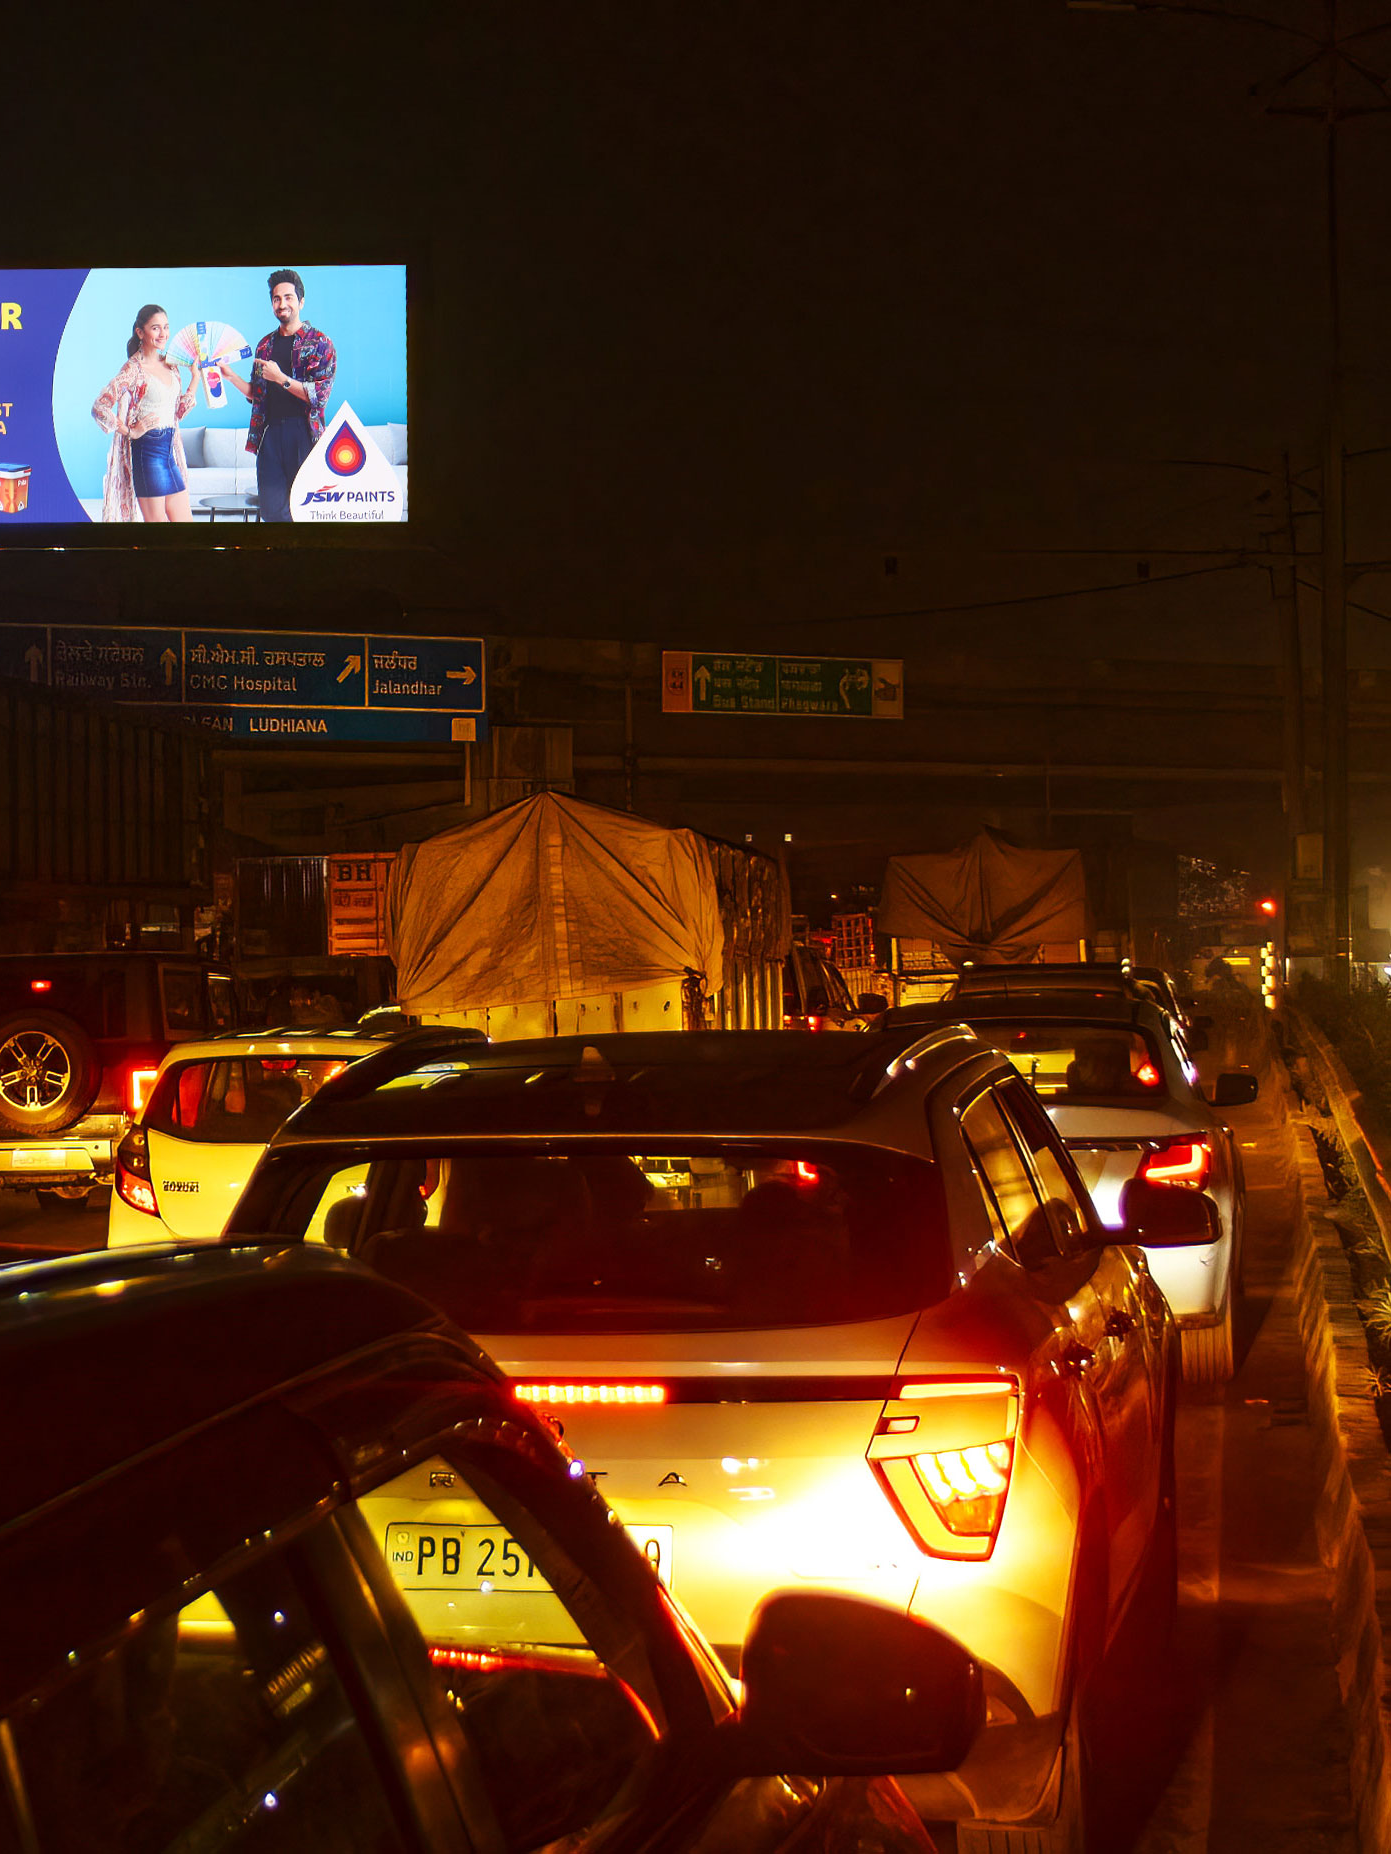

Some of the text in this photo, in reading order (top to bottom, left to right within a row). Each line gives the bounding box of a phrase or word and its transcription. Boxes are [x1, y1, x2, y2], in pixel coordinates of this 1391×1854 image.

[300, 491, 395, 506] JSW PAINTS
[310, 510, 384, 520] Think Beautiful
[56, 672, 115, 690] Railway
[189, 674, 297, 694] CMC Hospital
[373, 679, 443, 695] Jalandhar
[249, 717, 328, 733] LUDHIANA
[392, 1551, 414, 1562] IND
[417, 1536, 461, 1576] PB
